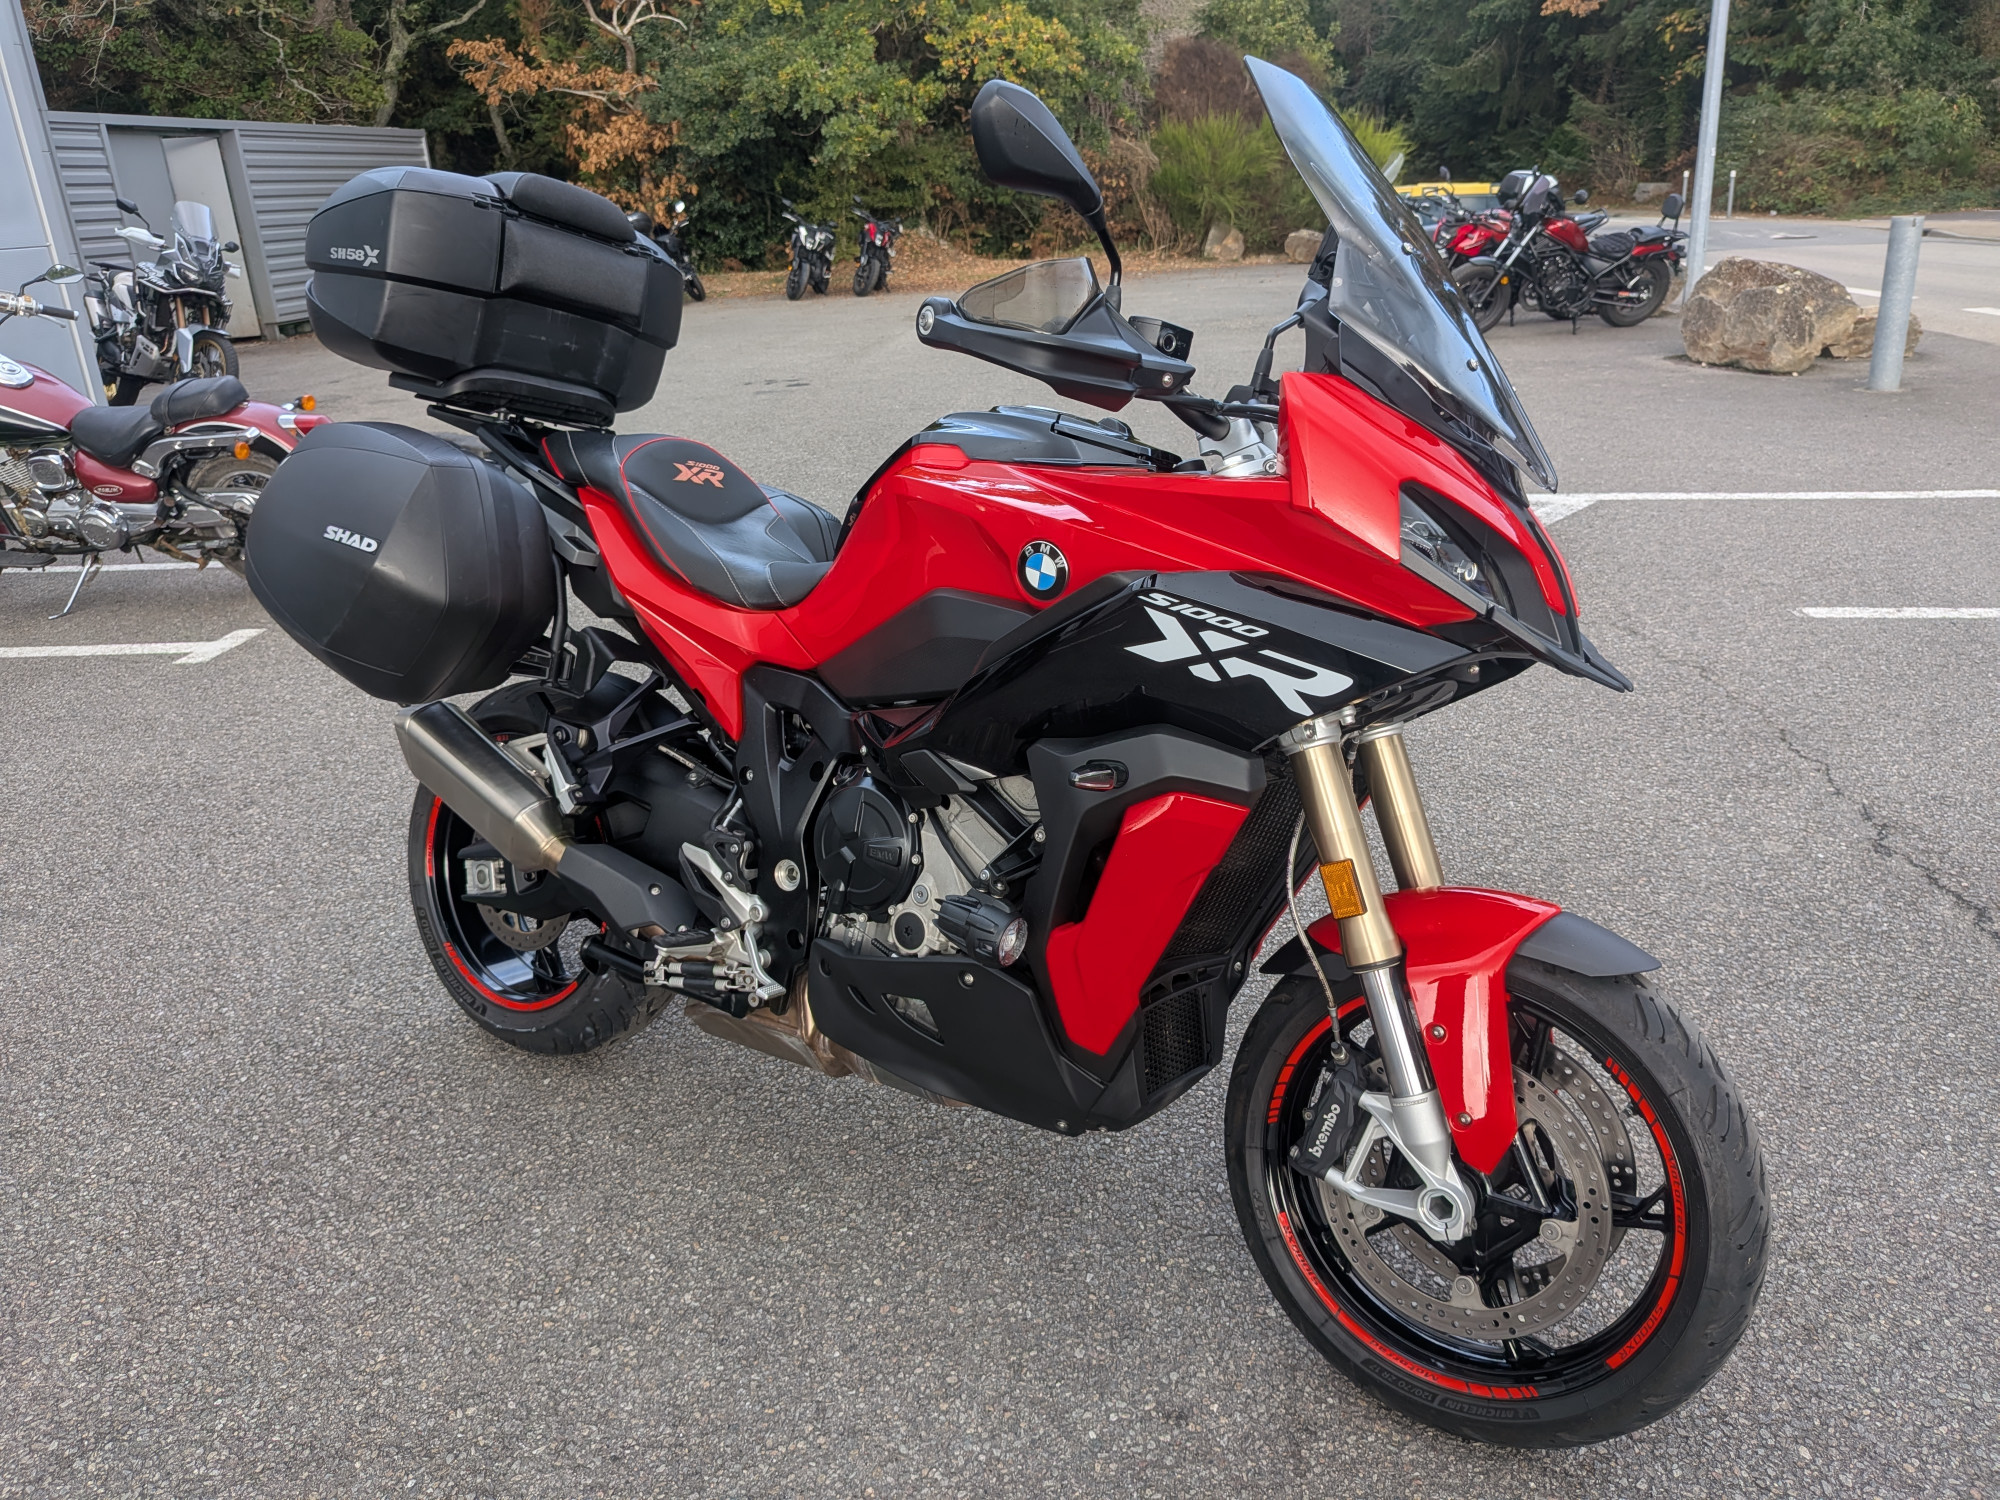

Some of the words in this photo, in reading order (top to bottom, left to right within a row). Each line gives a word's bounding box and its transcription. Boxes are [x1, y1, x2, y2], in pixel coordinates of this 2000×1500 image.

[672, 462, 724, 488] XR
[323, 525, 378, 552] SHAD
[1024, 543, 1065, 568] BMW
[1138, 592, 1270, 638] S1000
[1123, 606, 1354, 716] XR
[421, 920, 438, 951] ROAD
[437, 960, 475, 1004] MICHELIN
[1308, 1103, 1341, 1158] brembo
[1667, 1153, 1685, 1236] Motorrad
[1619, 1306, 1663, 1360] S1000XR
[1368, 1338, 1439, 1382] Motorrad
[1398, 1380, 1434, 1401] 120/70
[1444, 1396, 1515, 1419] MICHELIN
